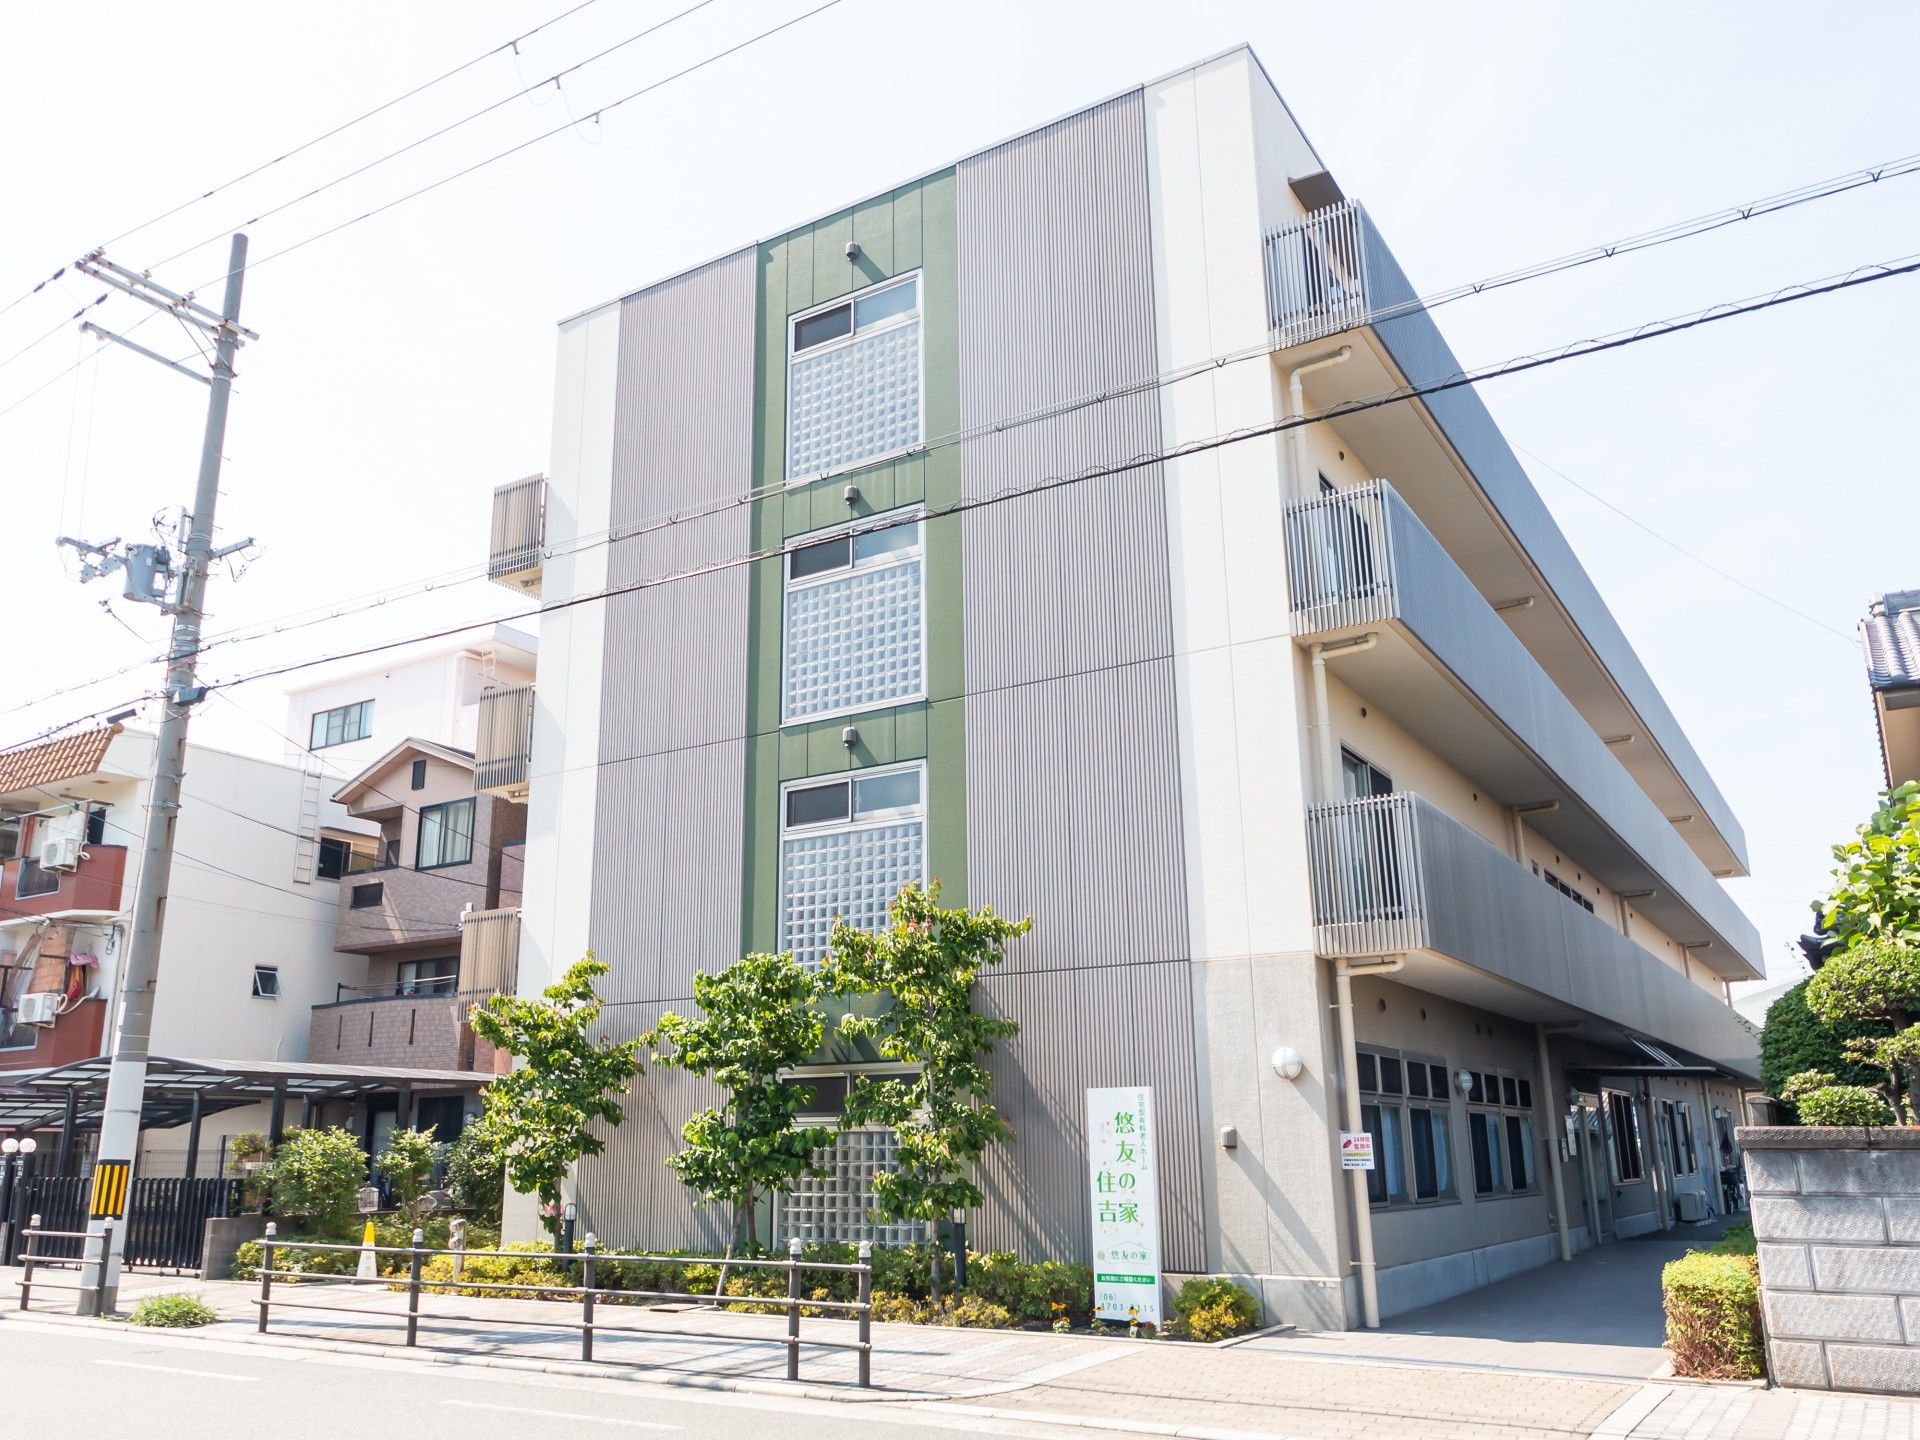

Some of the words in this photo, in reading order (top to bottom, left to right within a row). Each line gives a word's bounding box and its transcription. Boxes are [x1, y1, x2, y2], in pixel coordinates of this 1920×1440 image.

[1114, 1111, 1139, 1223] 悠友の家
[1097, 1171, 1118, 1223] 住吉
[1111, 1249, 1148, 1261] 悠友の家
[1100, 1292, 1117, 1301] (06)
[1101, 1302, 1154, 1313] 4703-115
